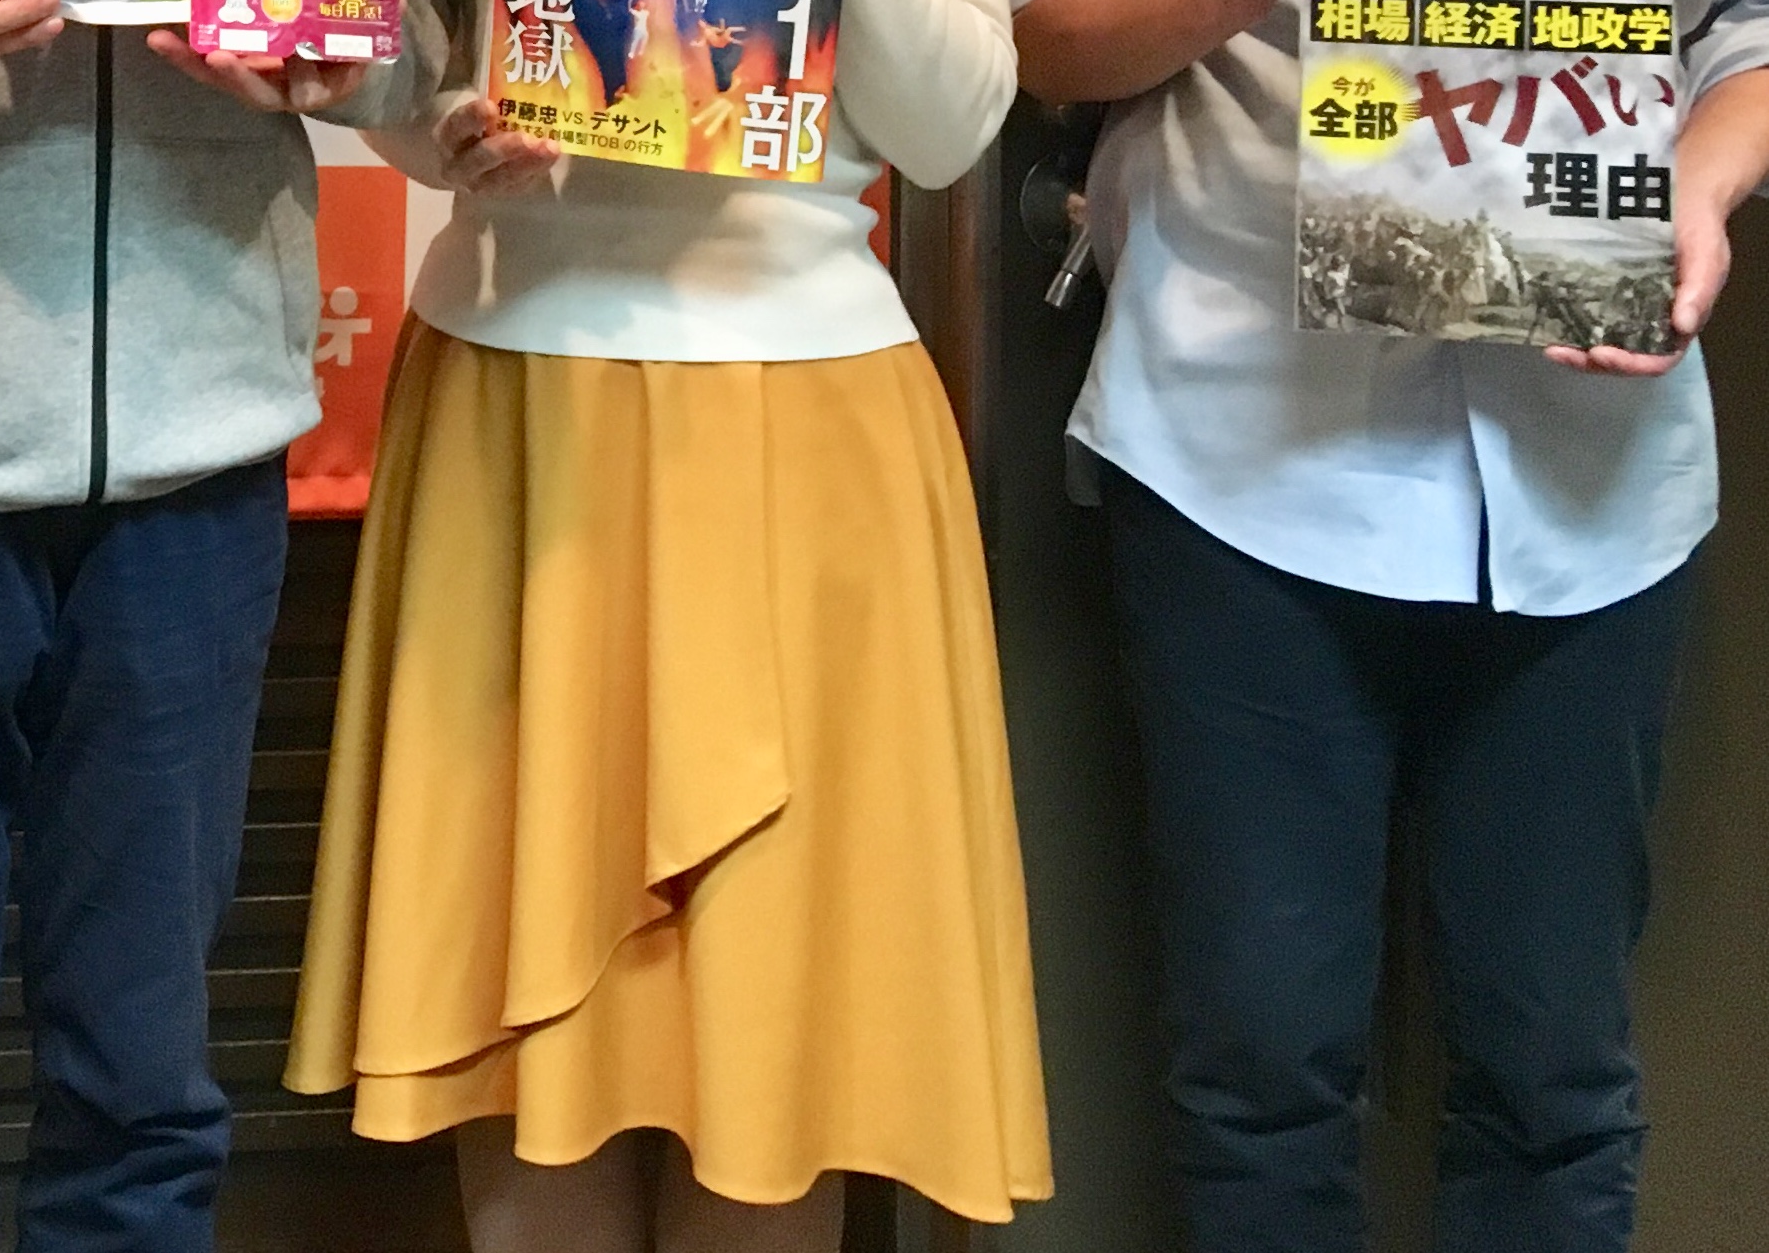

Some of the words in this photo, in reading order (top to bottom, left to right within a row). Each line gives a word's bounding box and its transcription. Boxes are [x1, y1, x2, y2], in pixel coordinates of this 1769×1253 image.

[1424, 0, 1521, 46] 経済
[1533, 5, 1672, 52] 地政学
[1332, 75, 1376, 96] 今が
[1415, 54, 1676, 168] ヤバい
[1309, 98, 1399, 141] 全部
[1523, 152, 1672, 223] 理由
